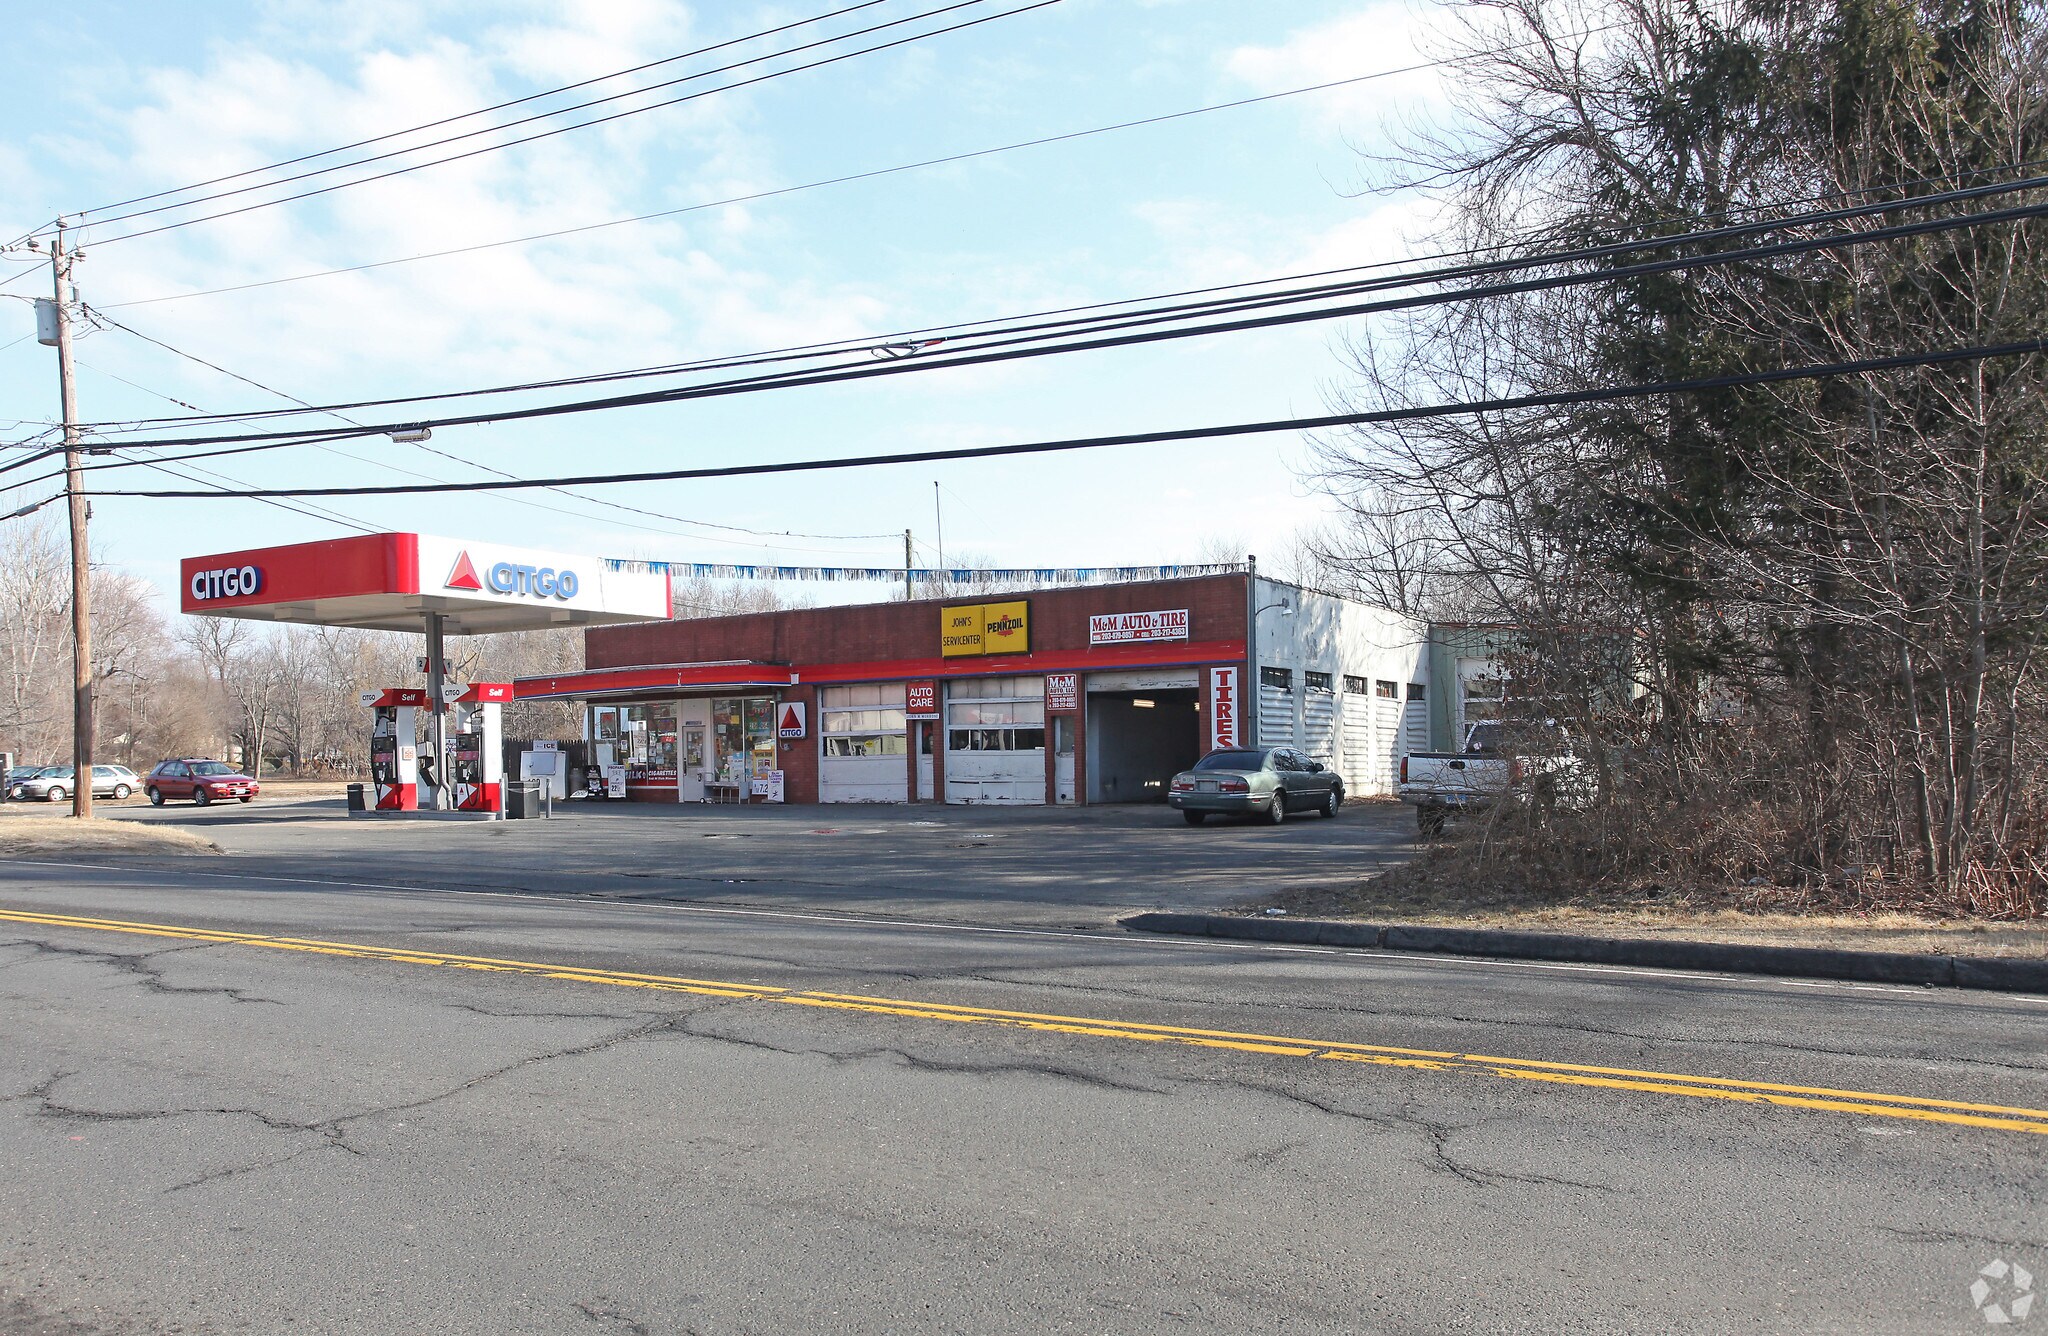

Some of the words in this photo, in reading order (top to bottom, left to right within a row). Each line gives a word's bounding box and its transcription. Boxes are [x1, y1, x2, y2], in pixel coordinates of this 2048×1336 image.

[191, 565, 257, 600] CITGO
[490, 562, 579, 598] CITGO
[951, 616, 972, 628] JOHN'S
[987, 617, 1024, 634] PENNZOIL
[1092, 617, 1118, 631] M&M
[1121, 614, 1151, 629] AUTO
[1159, 612, 1186, 627] TIRE
[943, 634, 981, 647] SERVICENTER
[1049, 676, 1075, 688] M&M
[401, 693, 416, 701] Self
[488, 688, 504, 697] Self
[909, 687, 933, 697] AUTO
[909, 698, 933, 708] CARE
[1216, 670, 1233, 748] TIRES
[780, 729, 802, 737] CITGO
